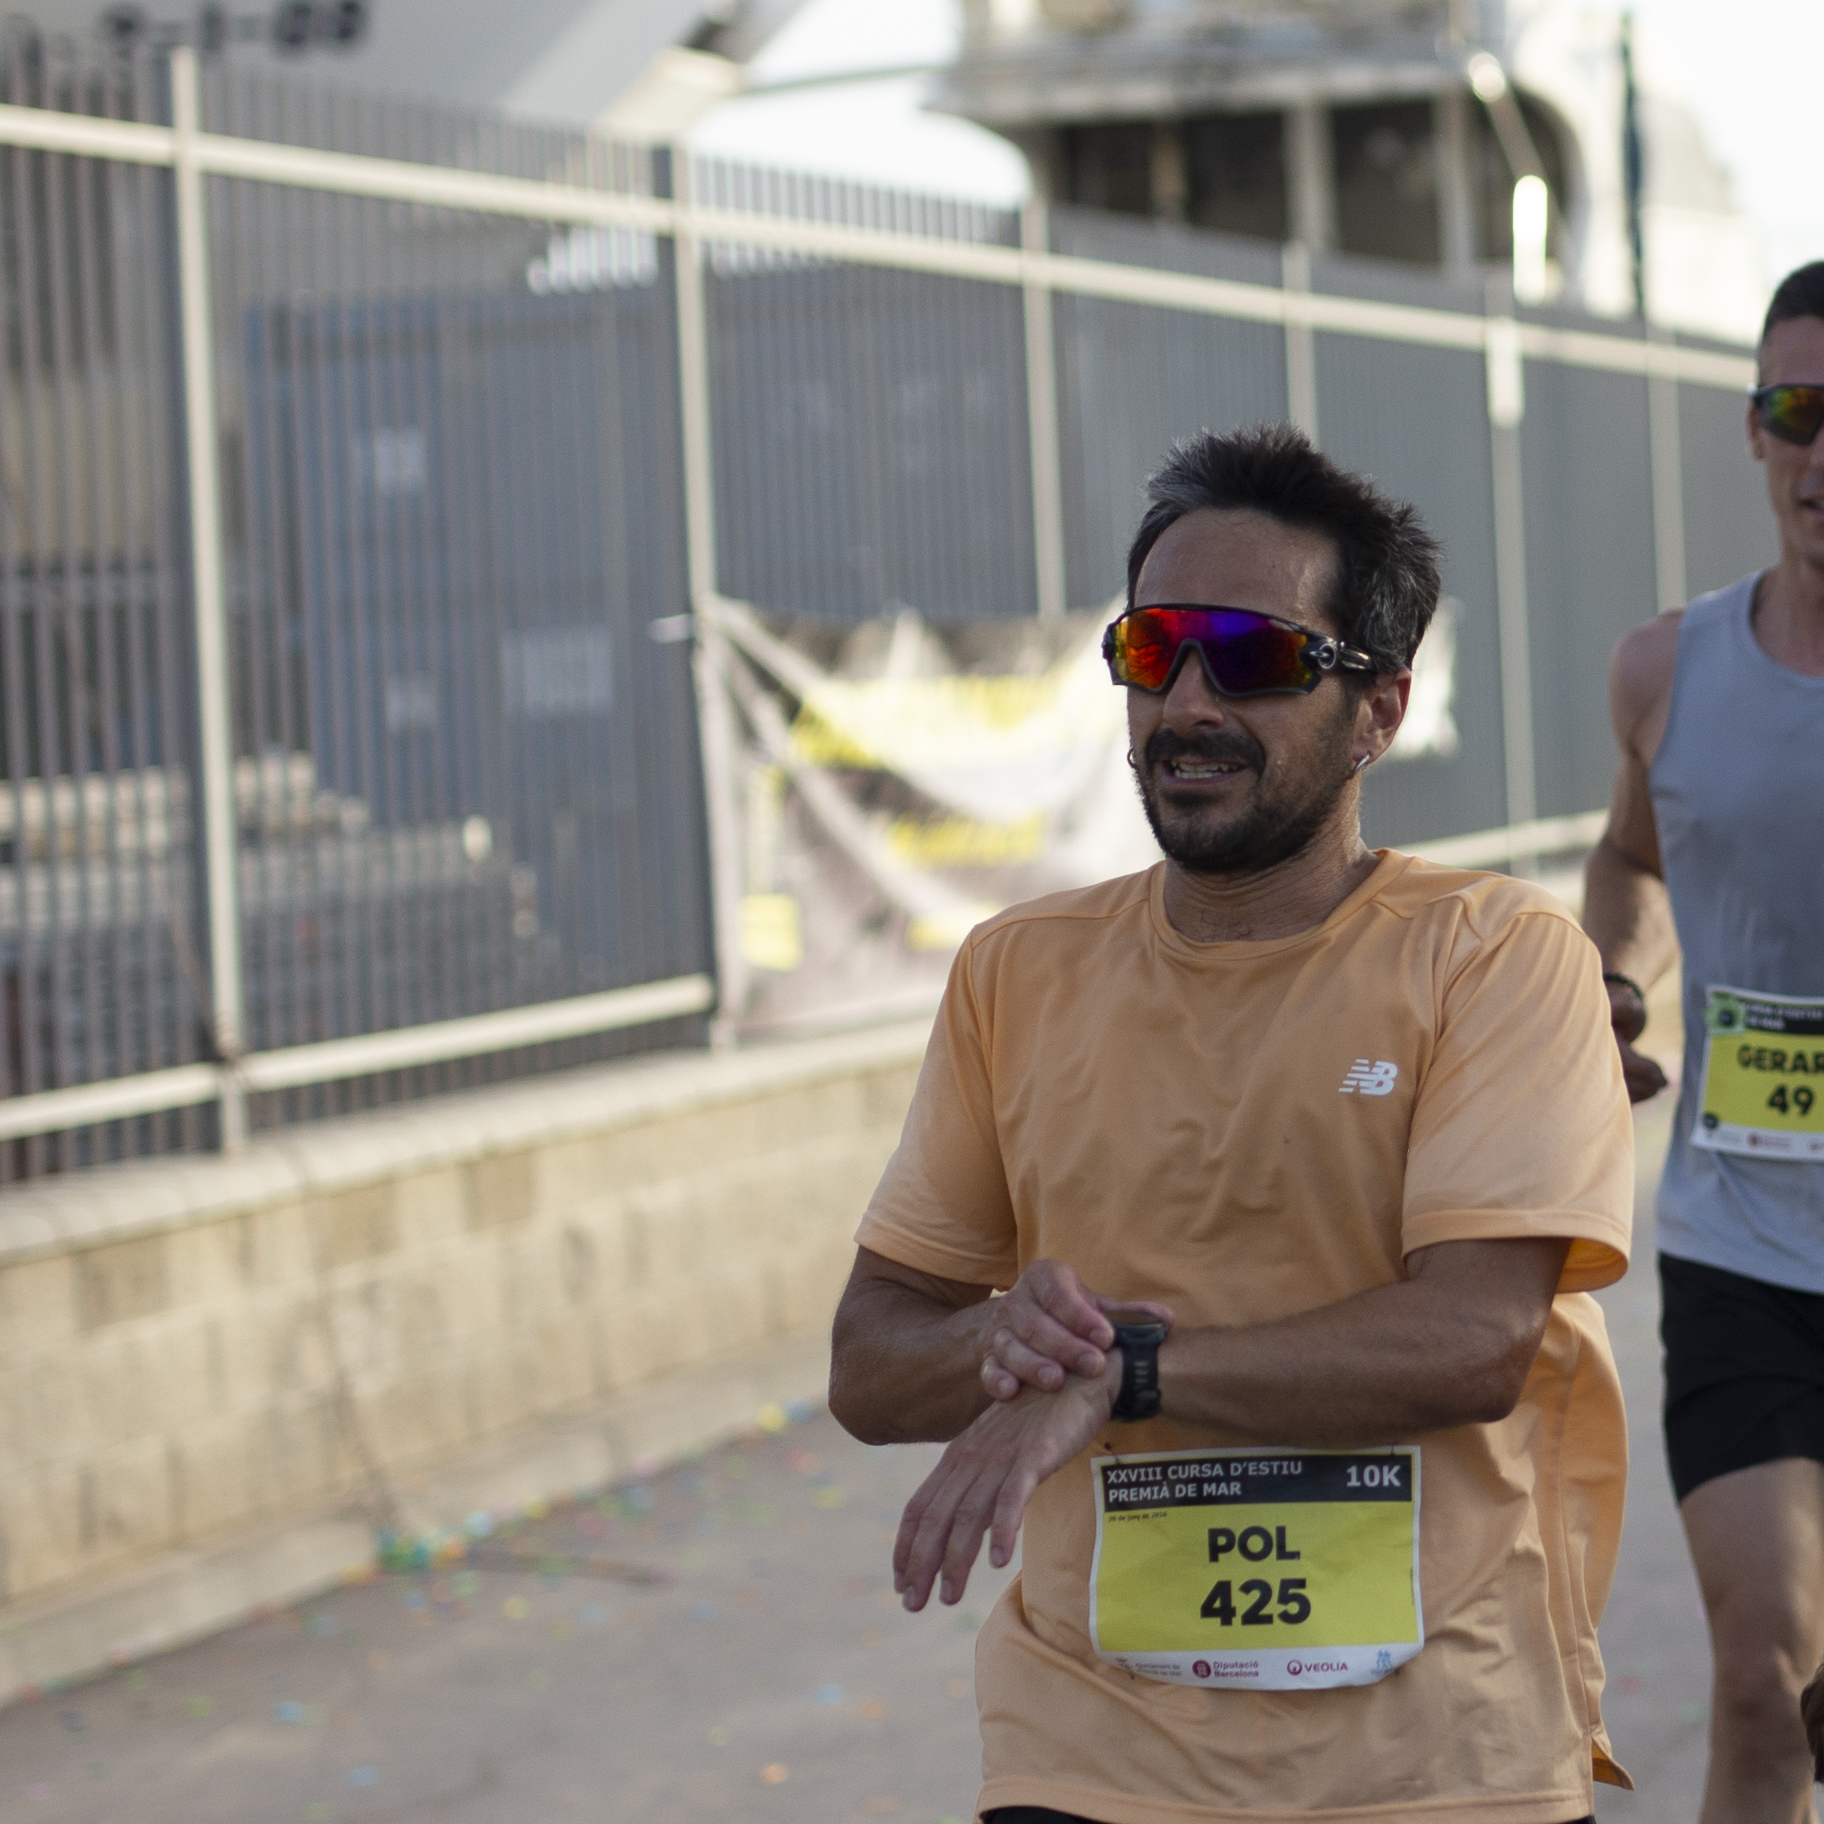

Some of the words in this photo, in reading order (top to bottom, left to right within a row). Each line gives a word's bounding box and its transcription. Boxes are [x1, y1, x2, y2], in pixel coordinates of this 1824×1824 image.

[1766, 1084, 1815, 1117] 49
[1107, 1466, 1163, 1484] XXVIII
[1167, 1463, 1224, 1480] CURSA
[1229, 1461, 1303, 1477] D'ESTIU
[1346, 1465, 1401, 1487] 10K
[1108, 1482, 1170, 1503] PREMIÀ
[1174, 1484, 1197, 1498] DE
[1202, 1482, 1242, 1497] MAR
[1208, 1525, 1301, 1562] POL
[1200, 1578, 1311, 1626] 425
[1213, 1660, 1259, 1670] Diputació
[1214, 1670, 1259, 1678] Barcelona
[1304, 1662, 1349, 1673] VEOLIA
